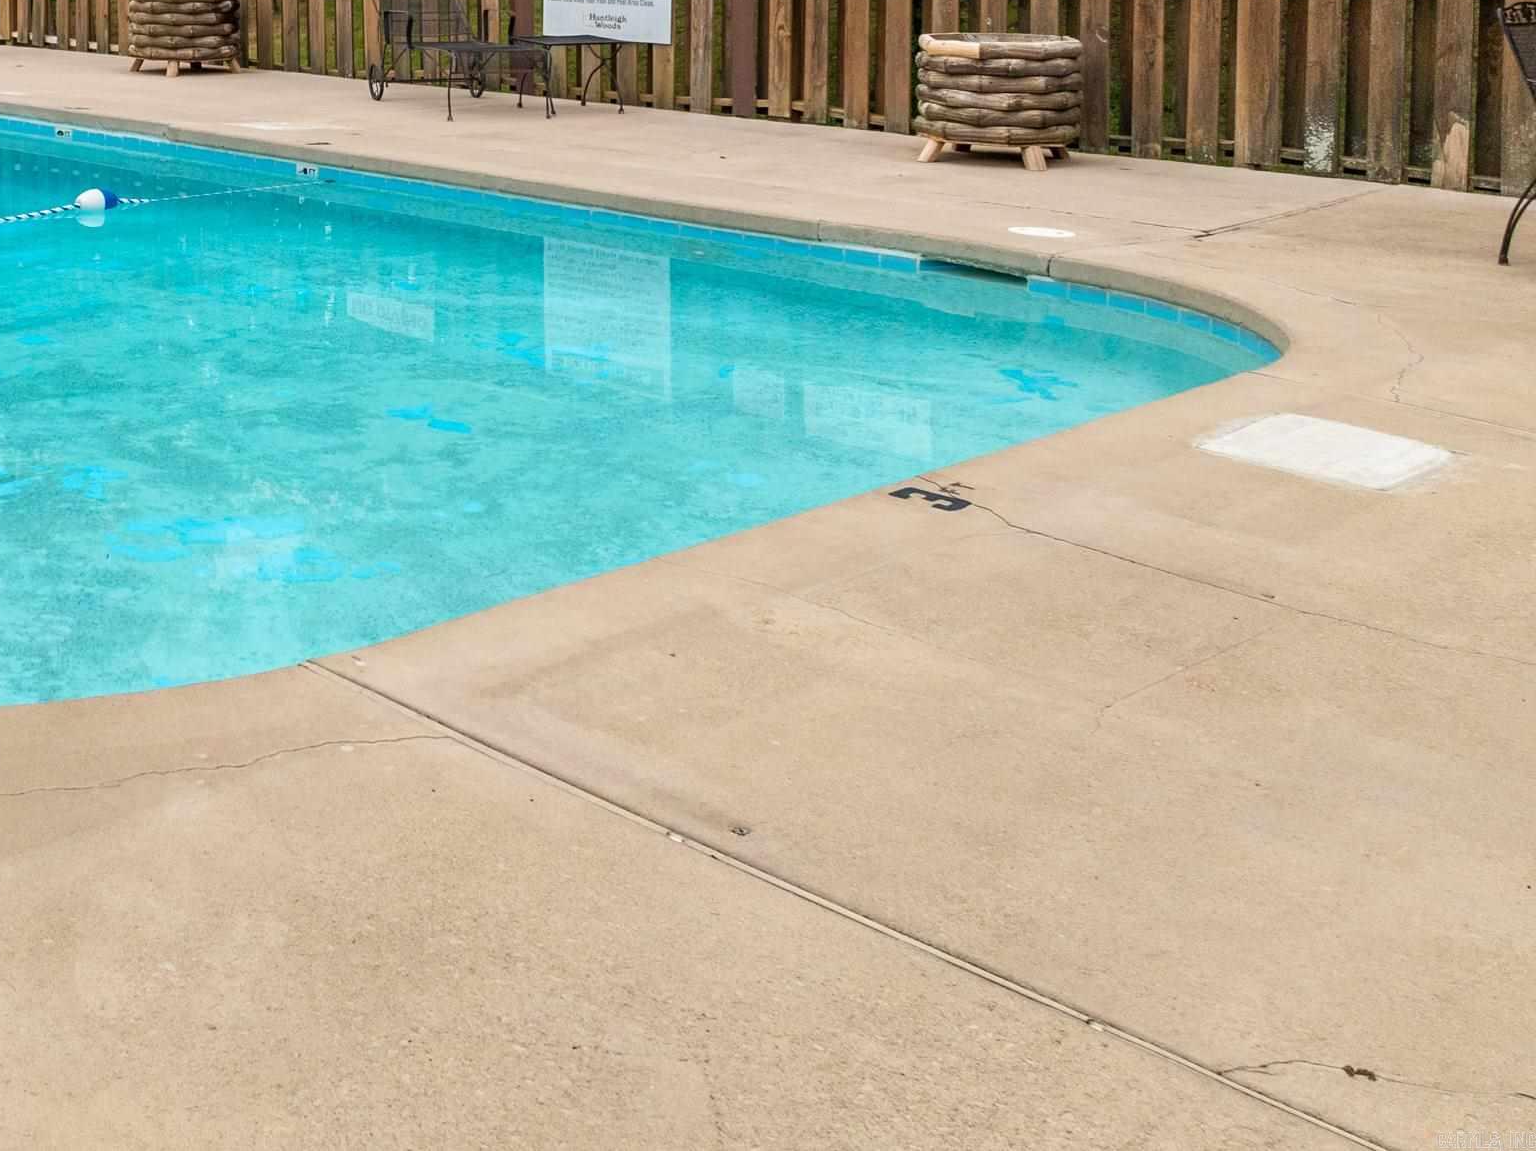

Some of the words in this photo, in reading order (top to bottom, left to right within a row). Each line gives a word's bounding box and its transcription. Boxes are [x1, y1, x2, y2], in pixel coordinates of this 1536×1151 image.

[589, 13, 627, 23] Huntleigh
[595, 22, 621, 30] Woods
[888, 487, 972, 511] 3
